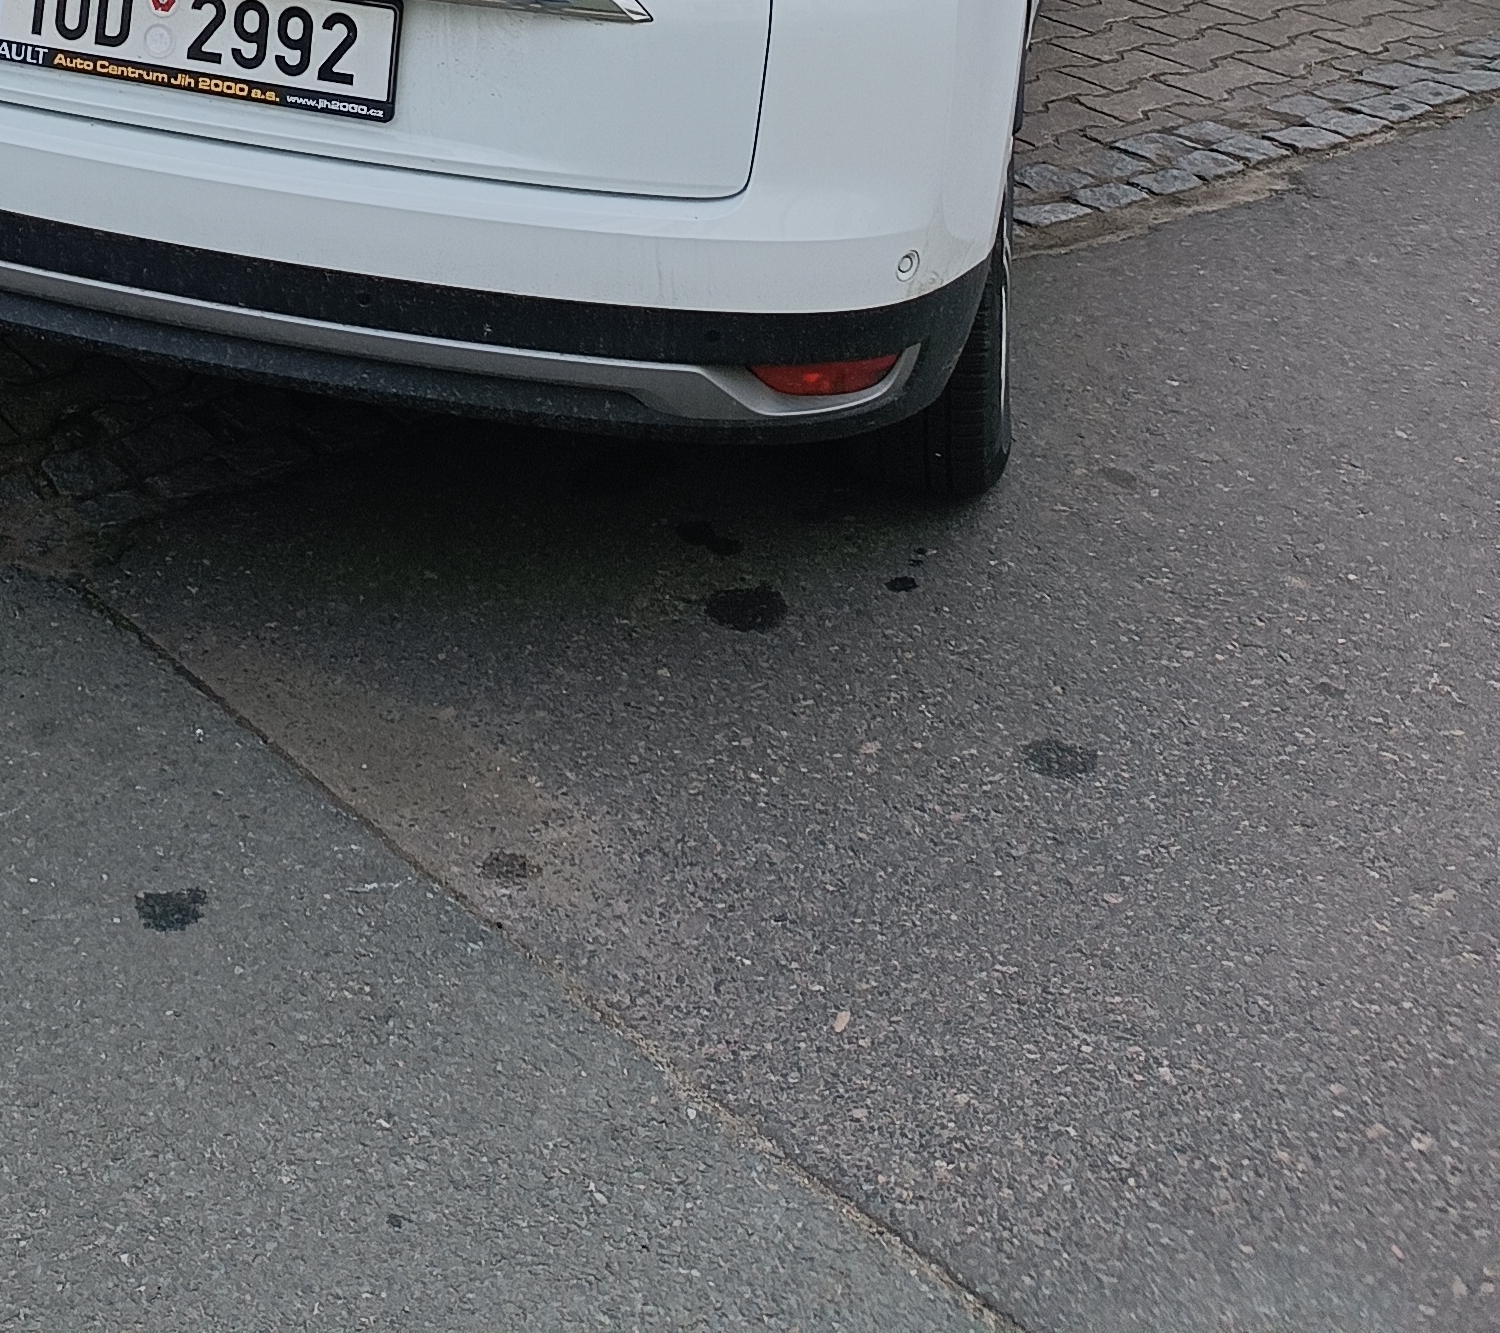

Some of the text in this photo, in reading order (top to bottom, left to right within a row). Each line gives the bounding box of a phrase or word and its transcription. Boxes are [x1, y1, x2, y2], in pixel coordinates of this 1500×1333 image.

[53, 52, 94, 71] Auto
[96, 60, 168, 84] Centrum
[170, 73, 195, 88] Jih
[198, 77, 249, 97] 2000
[251, 87, 280, 102] a.s.
[286, 94, 384, 118] www.jih2000.cz
